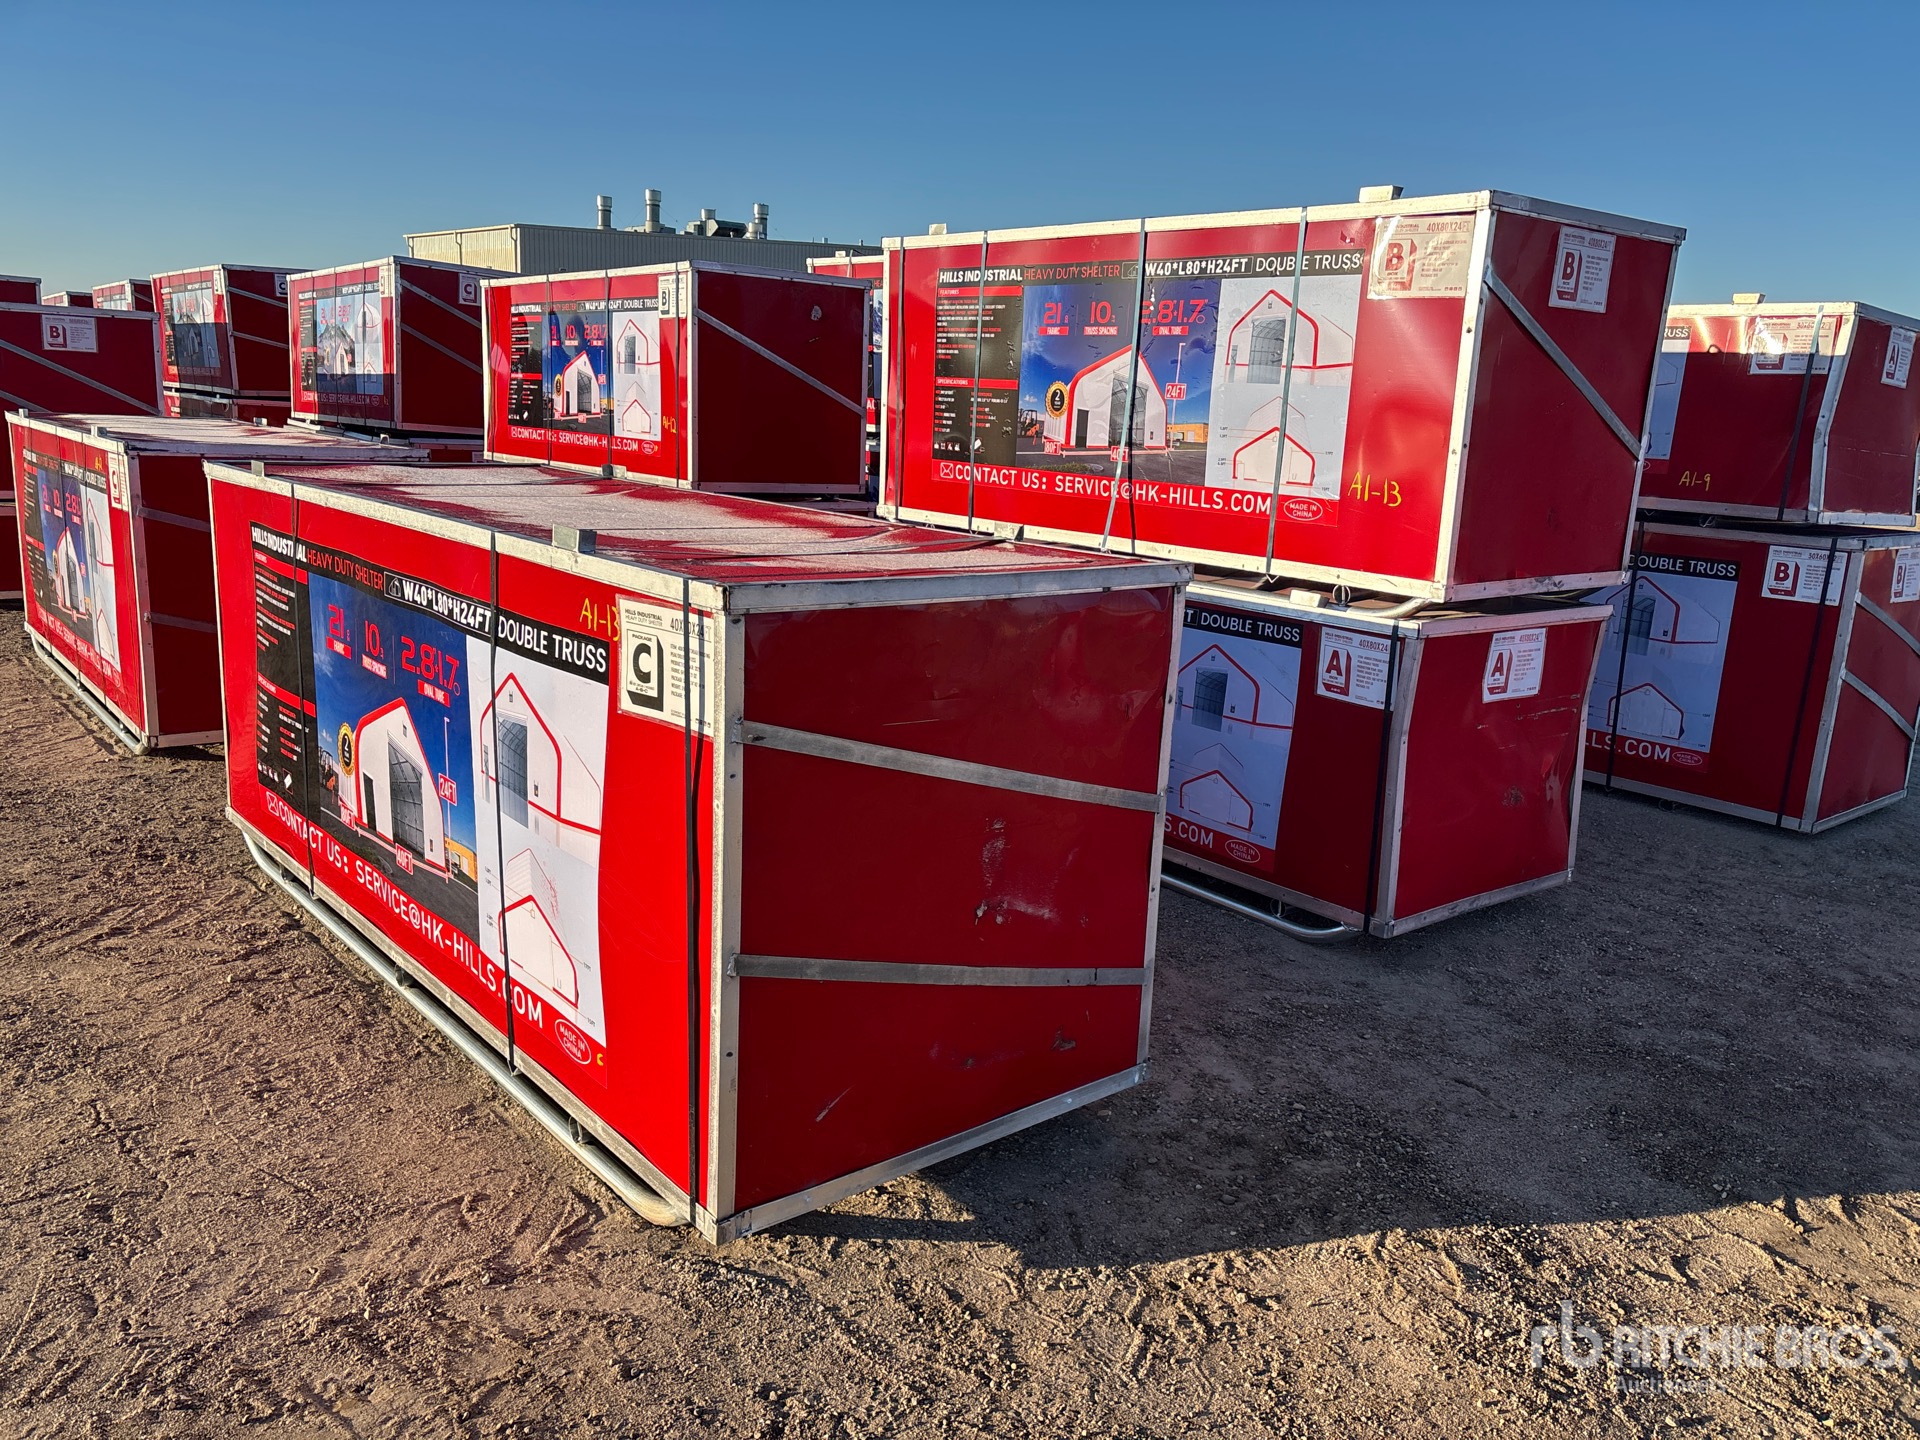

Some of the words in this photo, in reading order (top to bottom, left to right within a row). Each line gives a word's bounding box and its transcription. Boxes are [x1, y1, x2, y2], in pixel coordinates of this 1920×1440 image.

[939, 270, 964, 284] HILLS
[1023, 267, 1054, 280] HEAVY
[1055, 266, 1080, 279] DUTY
[1080, 264, 1120, 279] SHELTER
[1255, 255, 1309, 272] DOUBE
[1314, 252, 1360, 270] TRUSS
[1384, 242, 1405, 272] B
[1561, 251, 1576, 281] B
[278, 282, 286, 291] C
[463, 283, 473, 295] C
[623, 299, 644, 309] DOUBLE
[661, 290, 668, 307] B
[1043, 302, 1063, 325] 21
[1090, 301, 1112, 324] 10
[49, 325, 60, 339] B
[1166, 385, 1186, 399] 24FT
[517, 427, 545, 440] CONTACT
[955, 463, 1017, 485] CONTACT
[1290, 503, 1309, 511] MADE
[1310, 504, 1318, 512] IN
[1292, 510, 1313, 518] CHINA
[1688, 560, 1737, 577] TRUSS
[1774, 562, 1790, 582] B
[251, 526, 267, 546] HILLS
[307, 548, 333, 570] HEAVY
[334, 557, 354, 578] DUTY
[354, 563, 384, 591] SHELTER
[498, 615, 548, 655] DOUBLE
[552, 634, 607, 673] TRUSS
[624, 608, 637, 616] HILLS
[636, 610, 663, 621] INDUSTRIAL
[327, 603, 345, 639] 21
[364, 620, 381, 657] 10
[1200, 612, 1253, 634] DOUBLE
[1256, 621, 1300, 642] TRUSS
[632, 642, 651, 684] C
[1325, 649, 1343, 677] A
[1490, 652, 1505, 677] A
[343, 735, 349, 751] 2
[439, 779, 457, 802] 24FT
[277, 801, 324, 854] CONTACT
[396, 848, 413, 872] 40FT
[1230, 842, 1247, 854] MADE
[1248, 847, 1256, 856] IN
[1232, 849, 1252, 861] CHINA
[559, 1023, 577, 1046] MADE
[563, 1036, 583, 1060] CHINA
